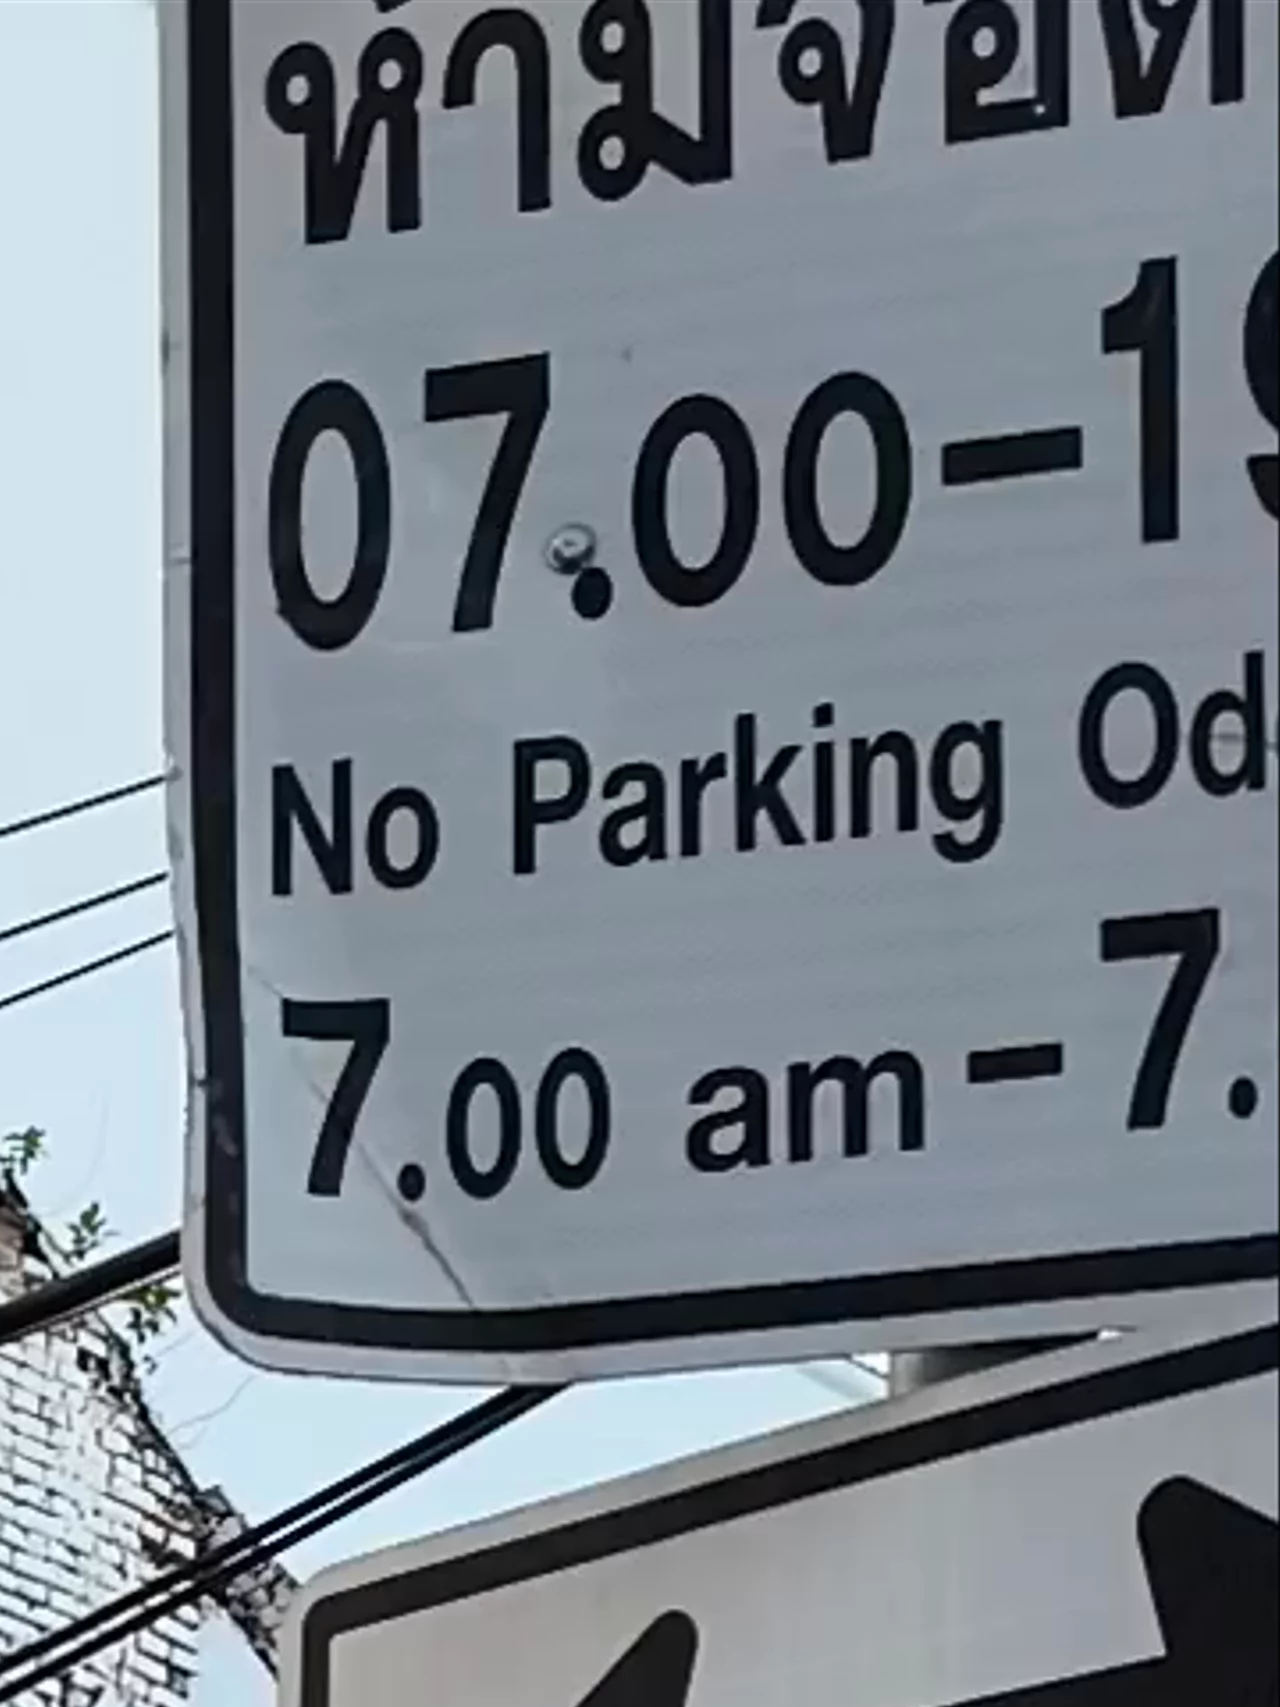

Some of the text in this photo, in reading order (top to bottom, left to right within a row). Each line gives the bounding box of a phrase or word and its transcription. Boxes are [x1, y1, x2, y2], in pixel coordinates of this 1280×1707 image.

[270, 650, 1280, 896] No Parking Od
[280, 998, 611, 1200] 7.00
